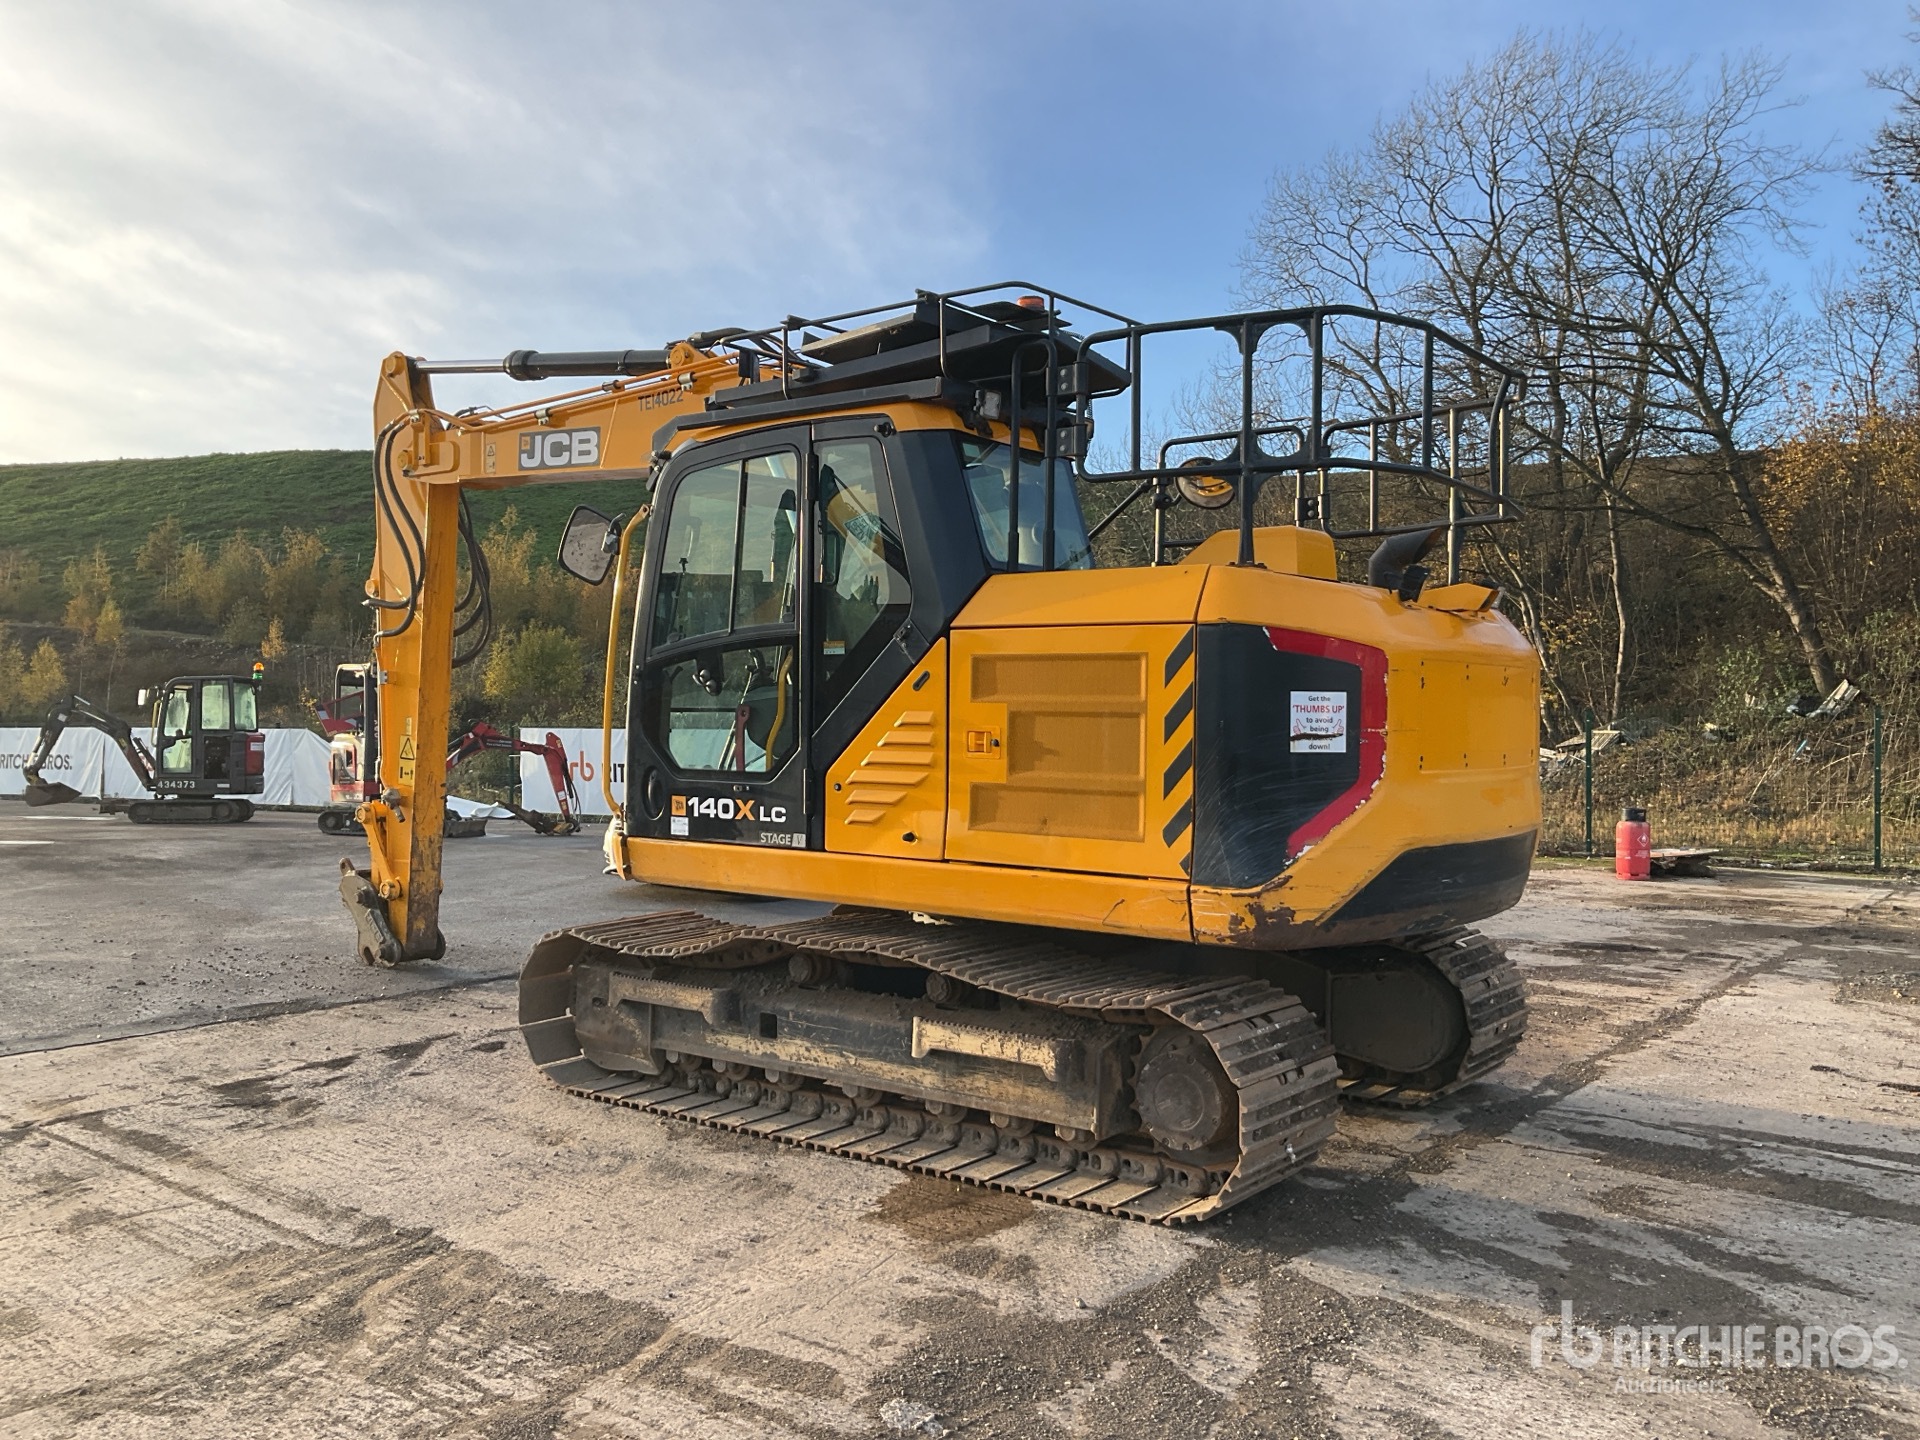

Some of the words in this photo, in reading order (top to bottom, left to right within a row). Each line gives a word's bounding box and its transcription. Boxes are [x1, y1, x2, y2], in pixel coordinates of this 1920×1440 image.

[520, 430, 598, 468] JCB
[157, 780, 195, 789] 434373
[688, 796, 755, 820] 140X
[759, 806, 787, 823] LC
[760, 832, 791, 845] STAGE
